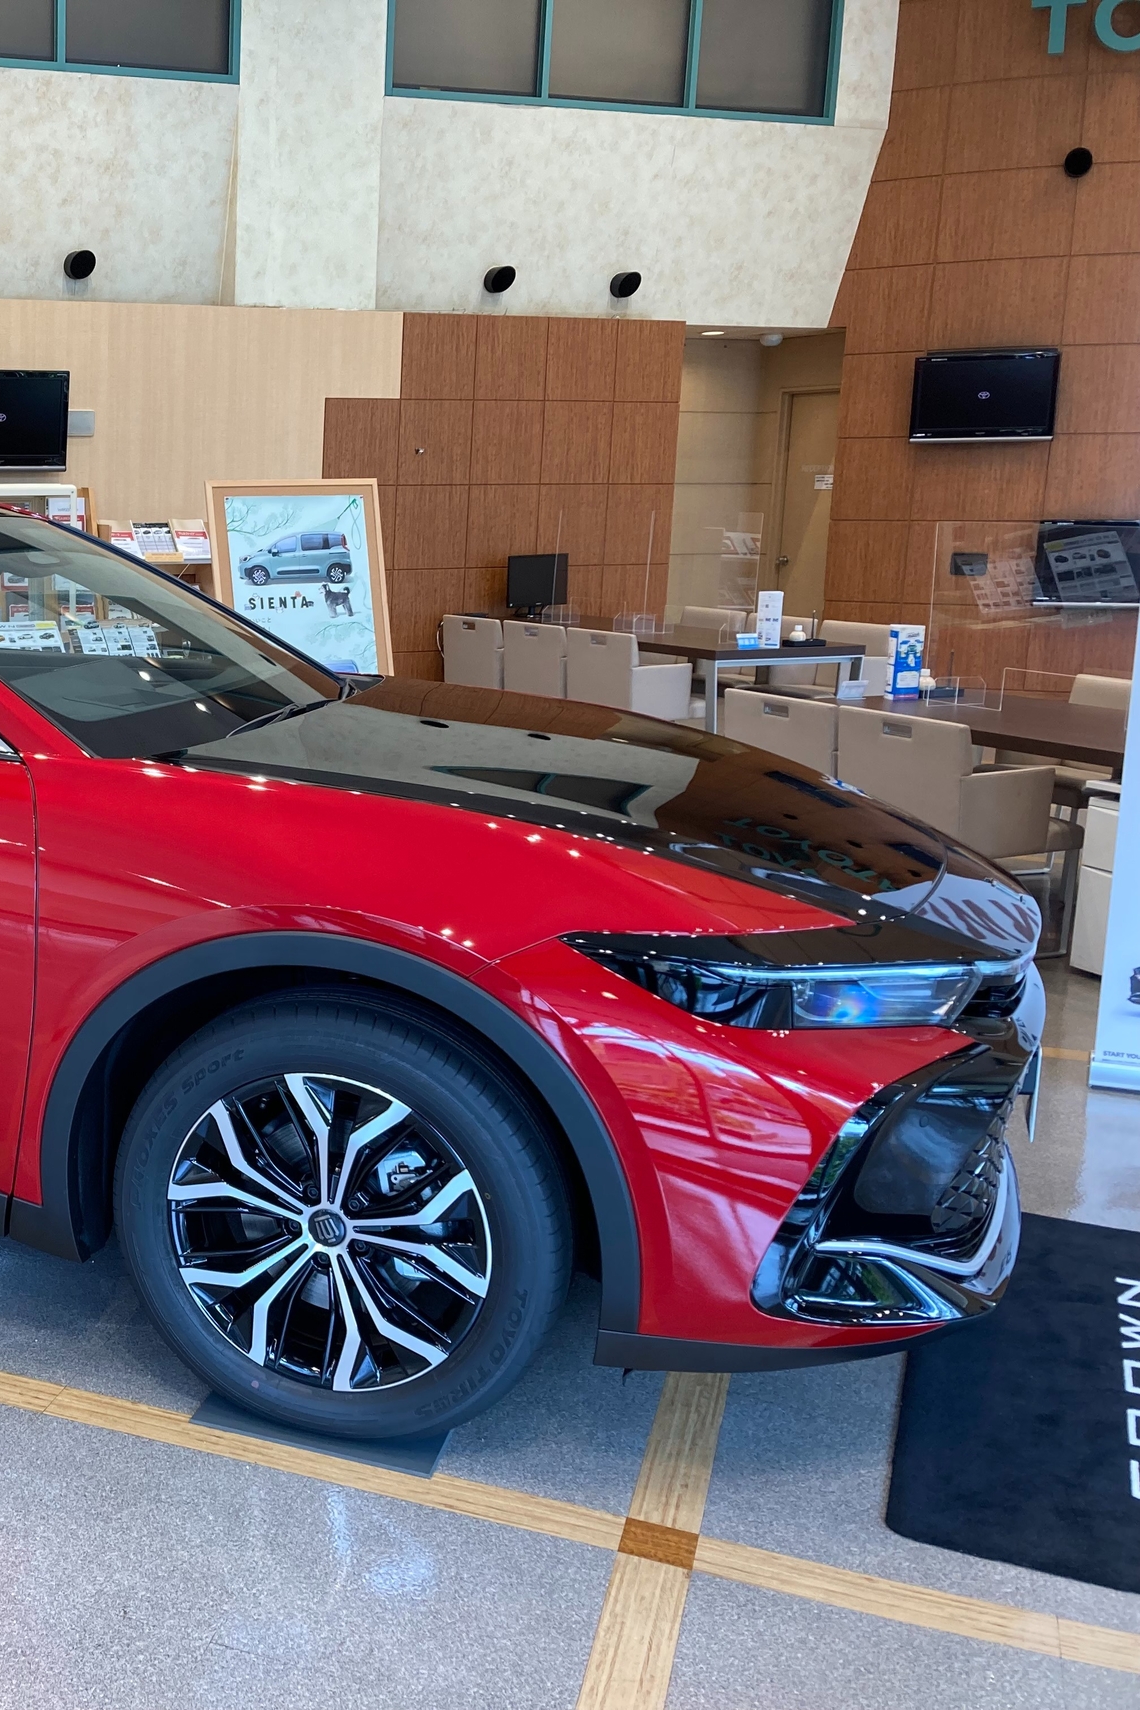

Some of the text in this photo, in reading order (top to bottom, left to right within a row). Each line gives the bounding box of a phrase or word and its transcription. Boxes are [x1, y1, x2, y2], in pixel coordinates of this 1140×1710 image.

[1031, 0, 1140, 54] TO
[248, 595, 309, 610] SIENTA
[1102, 1050, 1125, 1058] START
[414, 1288, 529, 1418] TOYO TIRES
